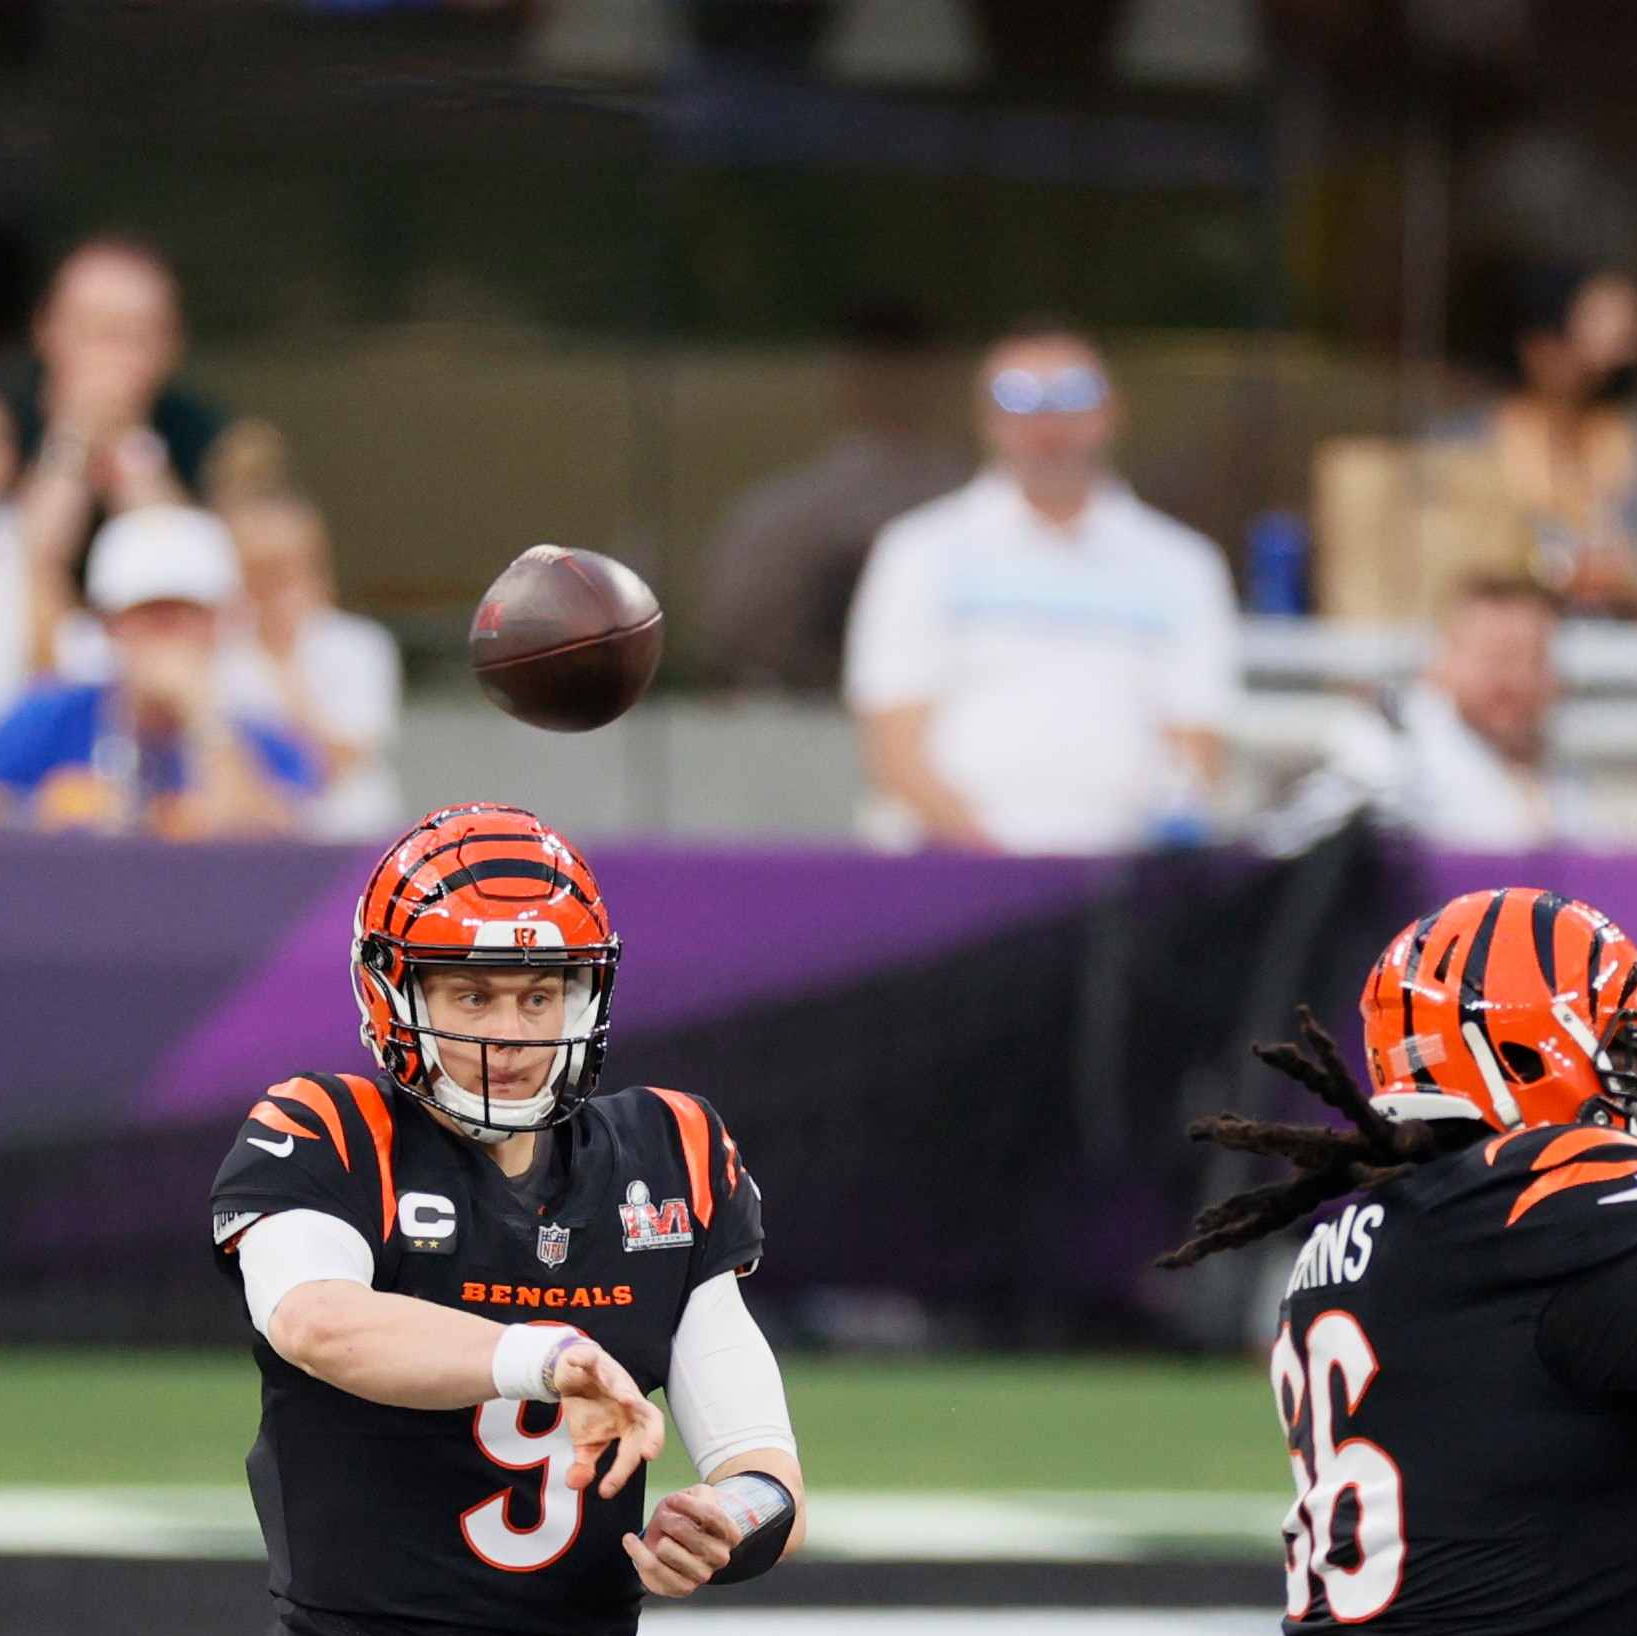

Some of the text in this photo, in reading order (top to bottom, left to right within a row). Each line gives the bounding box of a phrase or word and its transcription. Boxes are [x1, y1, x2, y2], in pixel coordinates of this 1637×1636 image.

[398, 1192, 456, 1238] C
[542, 1242, 564, 1259] NFL
[461, 1281, 635, 1308] BENGALS
[459, 1320, 594, 1573] 9
